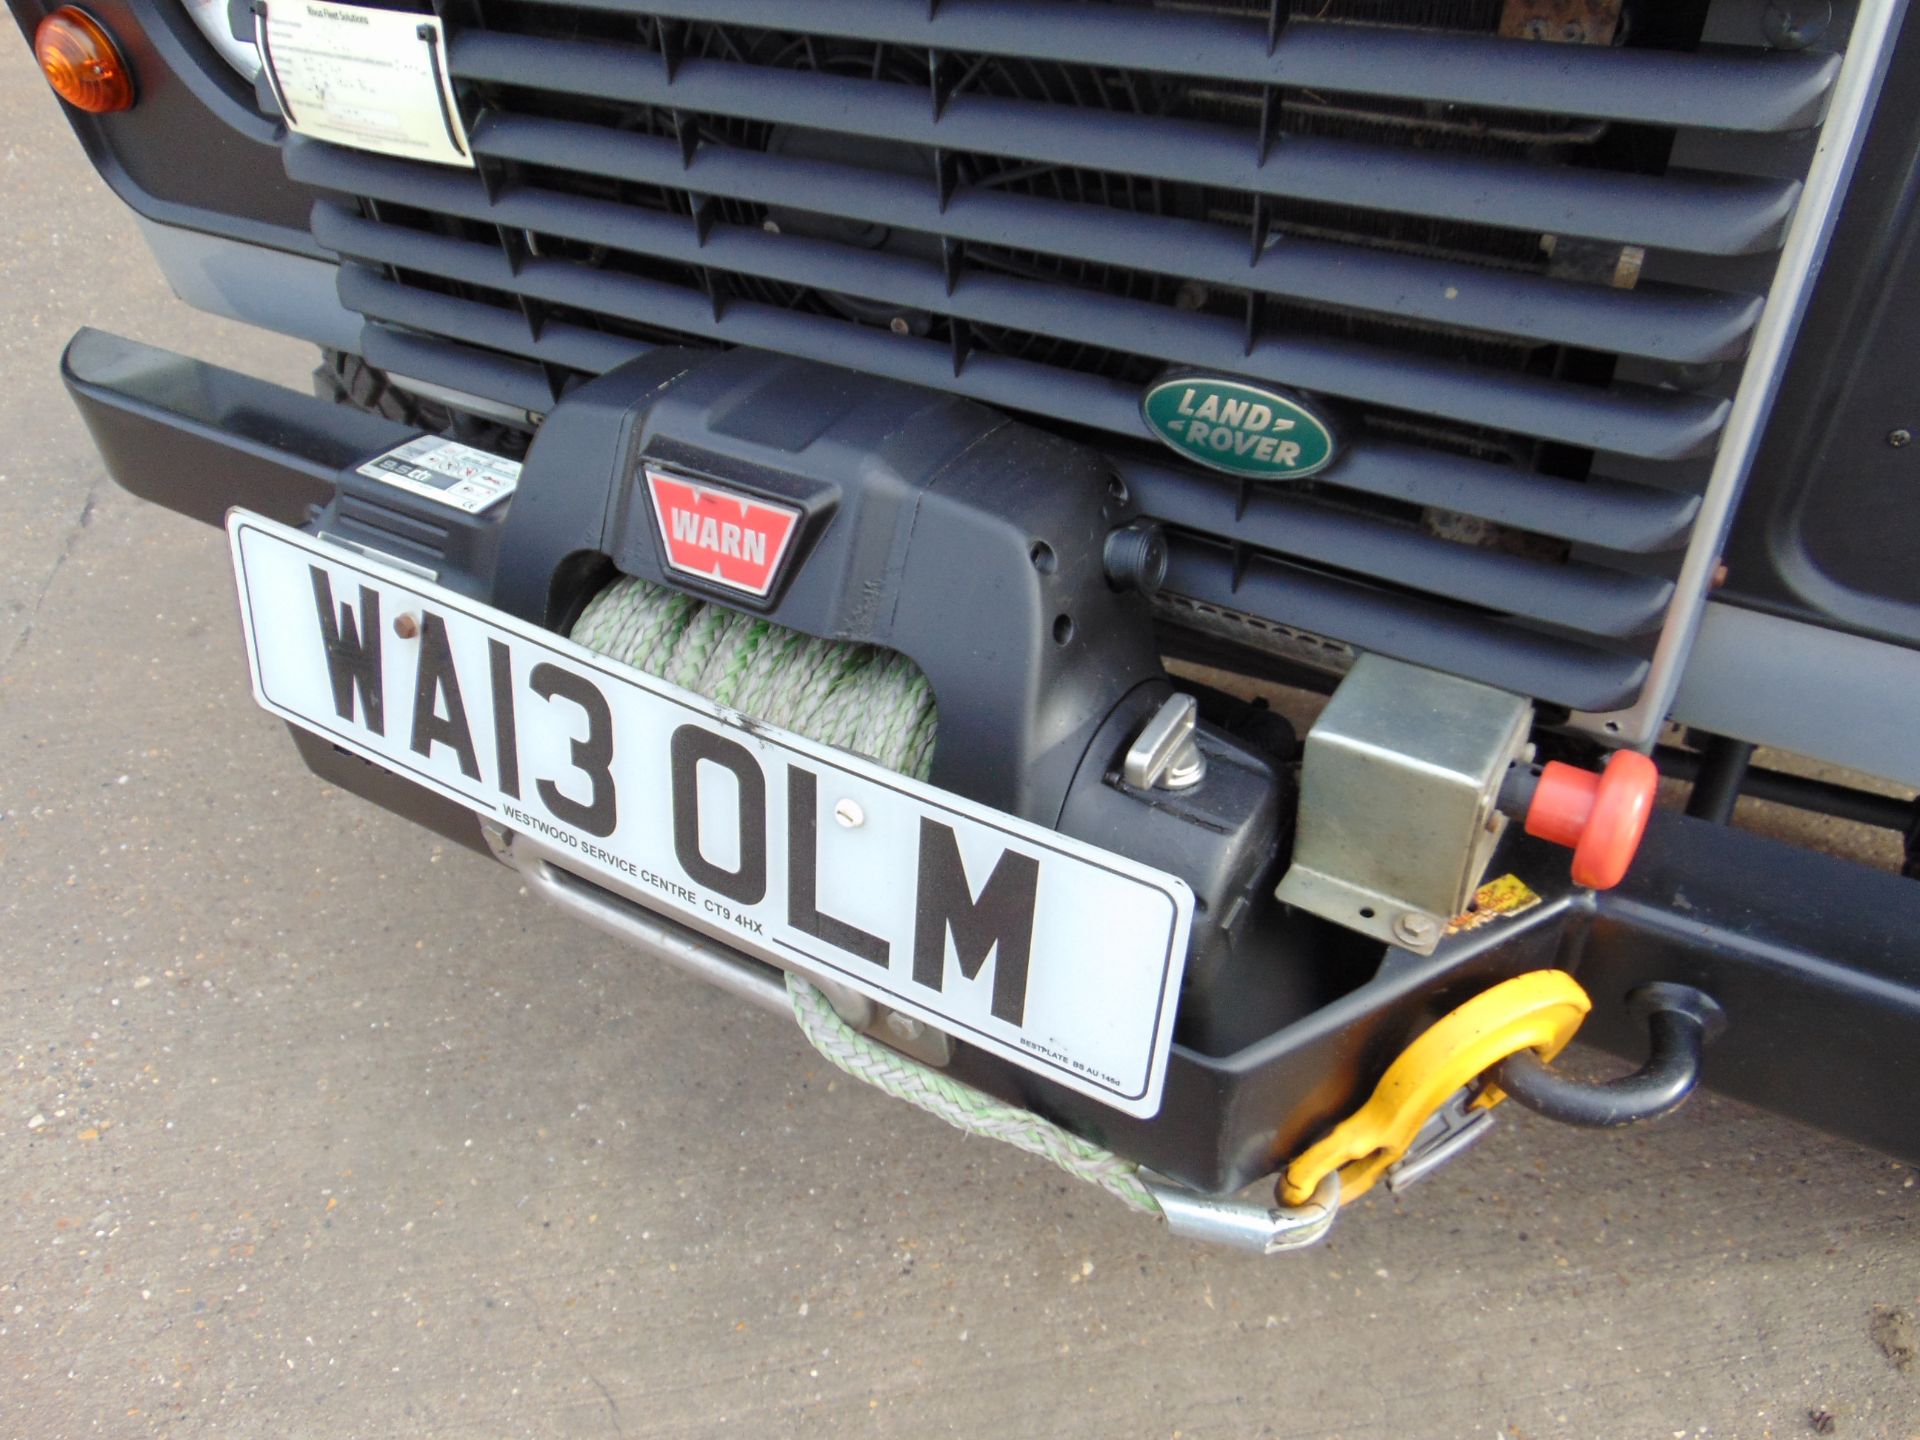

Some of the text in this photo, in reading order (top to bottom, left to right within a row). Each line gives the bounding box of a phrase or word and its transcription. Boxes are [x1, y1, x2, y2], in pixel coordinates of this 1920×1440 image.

[323, 8, 339, 20] Fleet
[339, 11, 369, 25] Solutions
[1177, 388, 1272, 432] LAND
[1185, 420, 1301, 467] ROVER
[671, 507, 766, 566] WARN
[308, 563, 1040, 1028] WA13 OLM
[503, 803, 763, 936] WESTWOOD SERVICE CENTRE CT9 4HX
[1020, 1037, 1068, 1064] BESTPLATE
[1072, 1060, 1084, 1071] BS
[1087, 1066, 1099, 1077] AU
